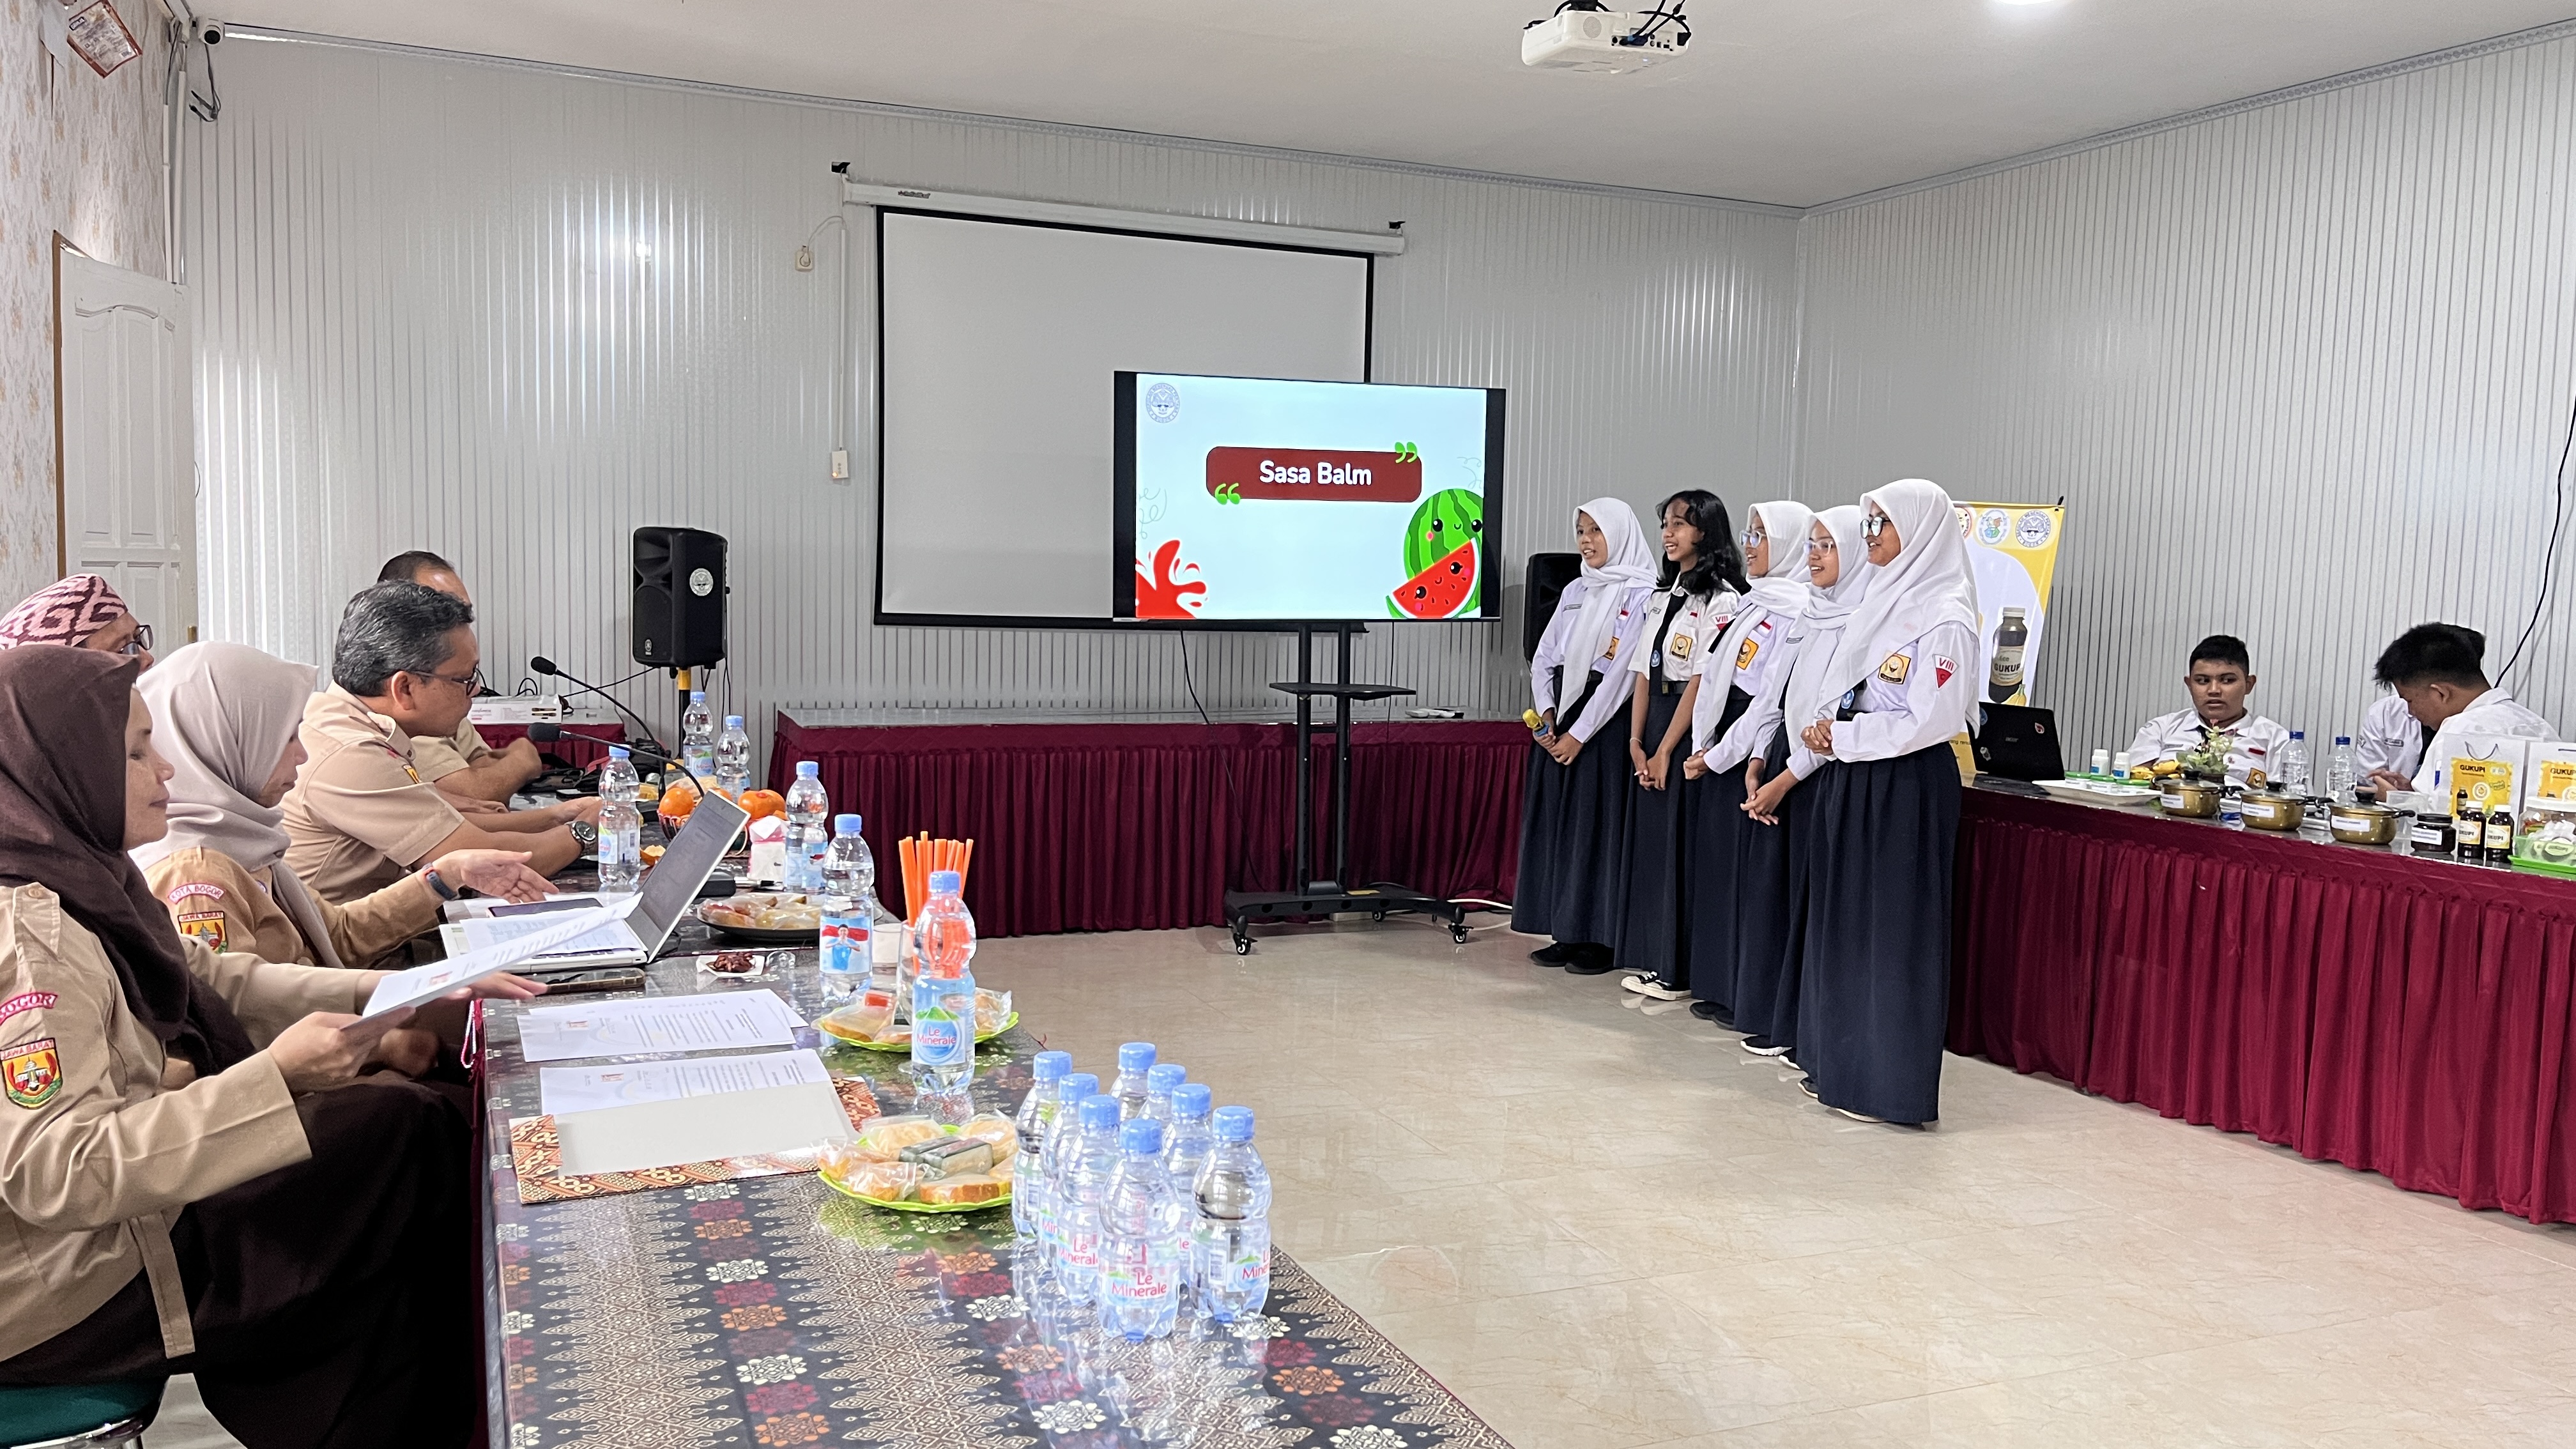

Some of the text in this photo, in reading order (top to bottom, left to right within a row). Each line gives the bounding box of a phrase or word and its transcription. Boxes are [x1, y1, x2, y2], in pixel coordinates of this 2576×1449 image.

[1259, 459, 1372, 486] Sasa Balm
[1715, 615, 1728, 623] VIII
[1939, 657, 1954, 671] VIII
[1994, 663, 2021, 673] GUKUP
[2460, 764, 2486, 773] GUKUPI
[2550, 767, 2576, 776] GUKUP
[171, 885, 222, 899] KOTA BOGOR
[928, 1025, 940, 1036] Le
[916, 1033, 957, 1045] Minerale
[1, 1040, 54, 1060] JAWA BARAT
[1073, 1237, 1088, 1254] Le
[1137, 1271, 1153, 1285] Le
[1242, 1263, 1270, 1280] Mine
[1112, 1282, 1167, 1297] Minerale
